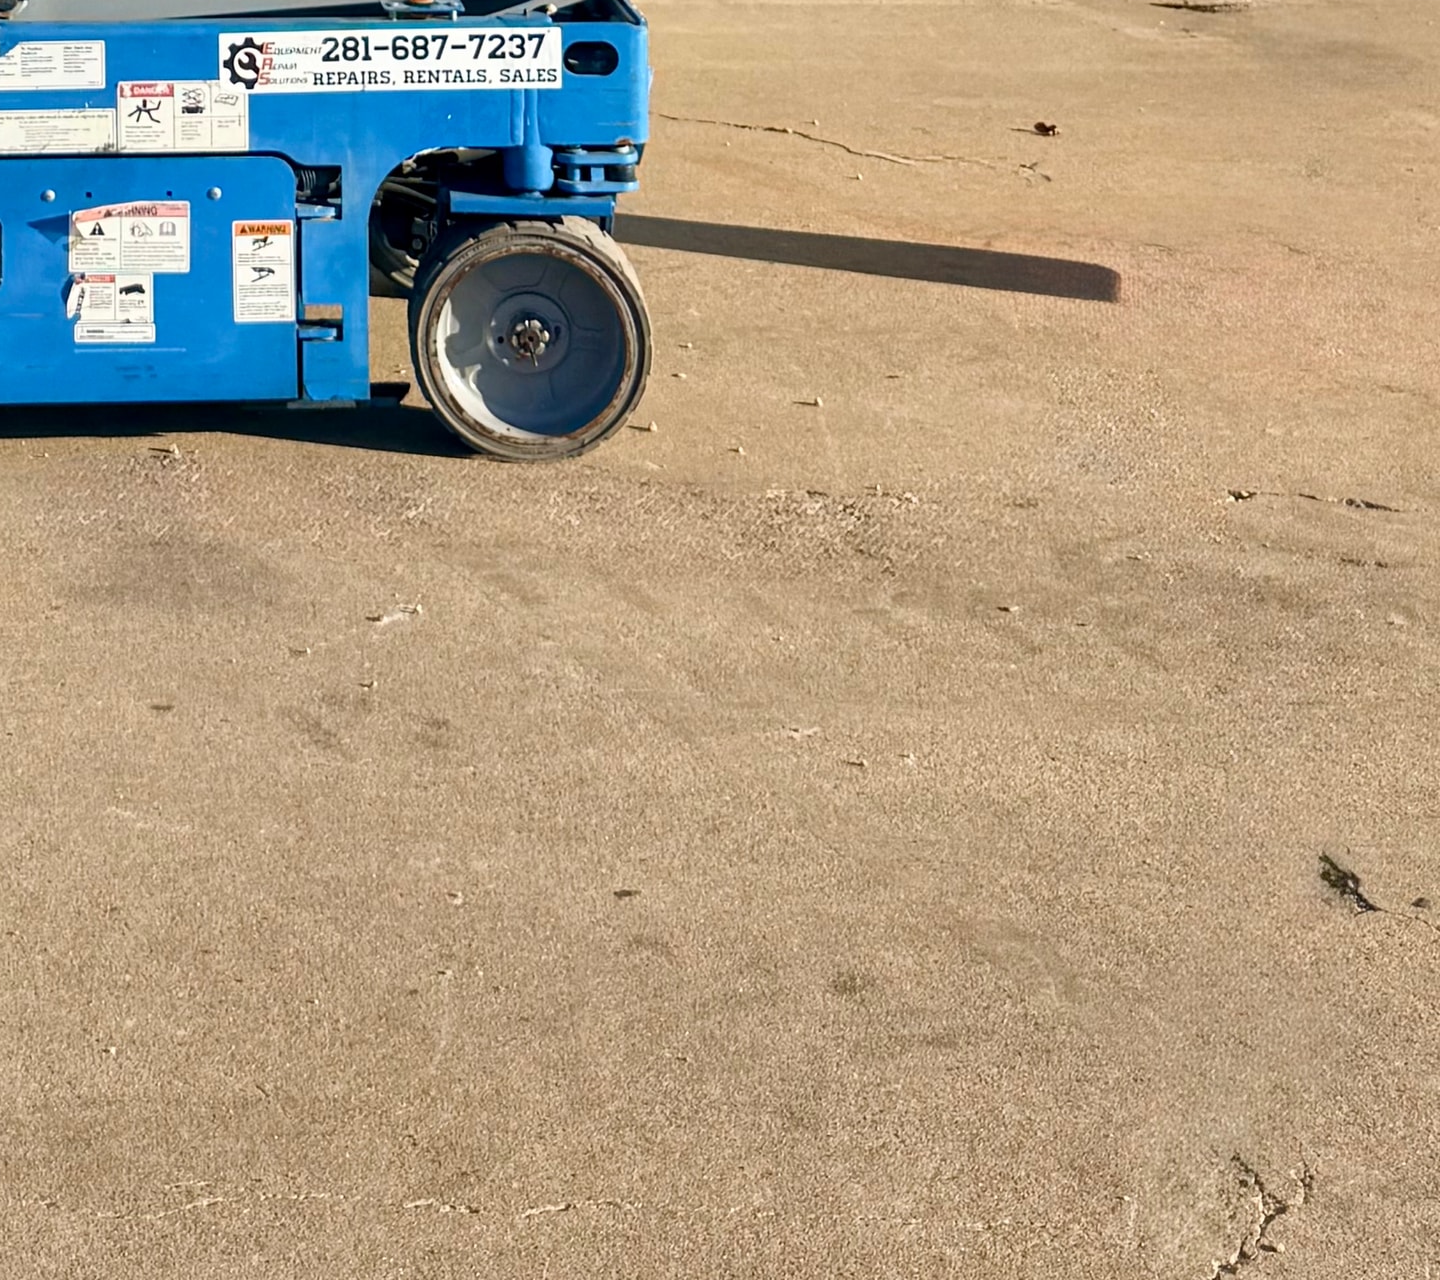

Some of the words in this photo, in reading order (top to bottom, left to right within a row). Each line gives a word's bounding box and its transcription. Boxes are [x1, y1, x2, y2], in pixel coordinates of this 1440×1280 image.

[321, 33, 544, 62] 281-687-7237
[313, 70, 396, 87] REPAIRS,
[403, 68, 493, 85] RENTALS,
[499, 67, 558, 83] SALES
[247, 224, 287, 234] WARNING
